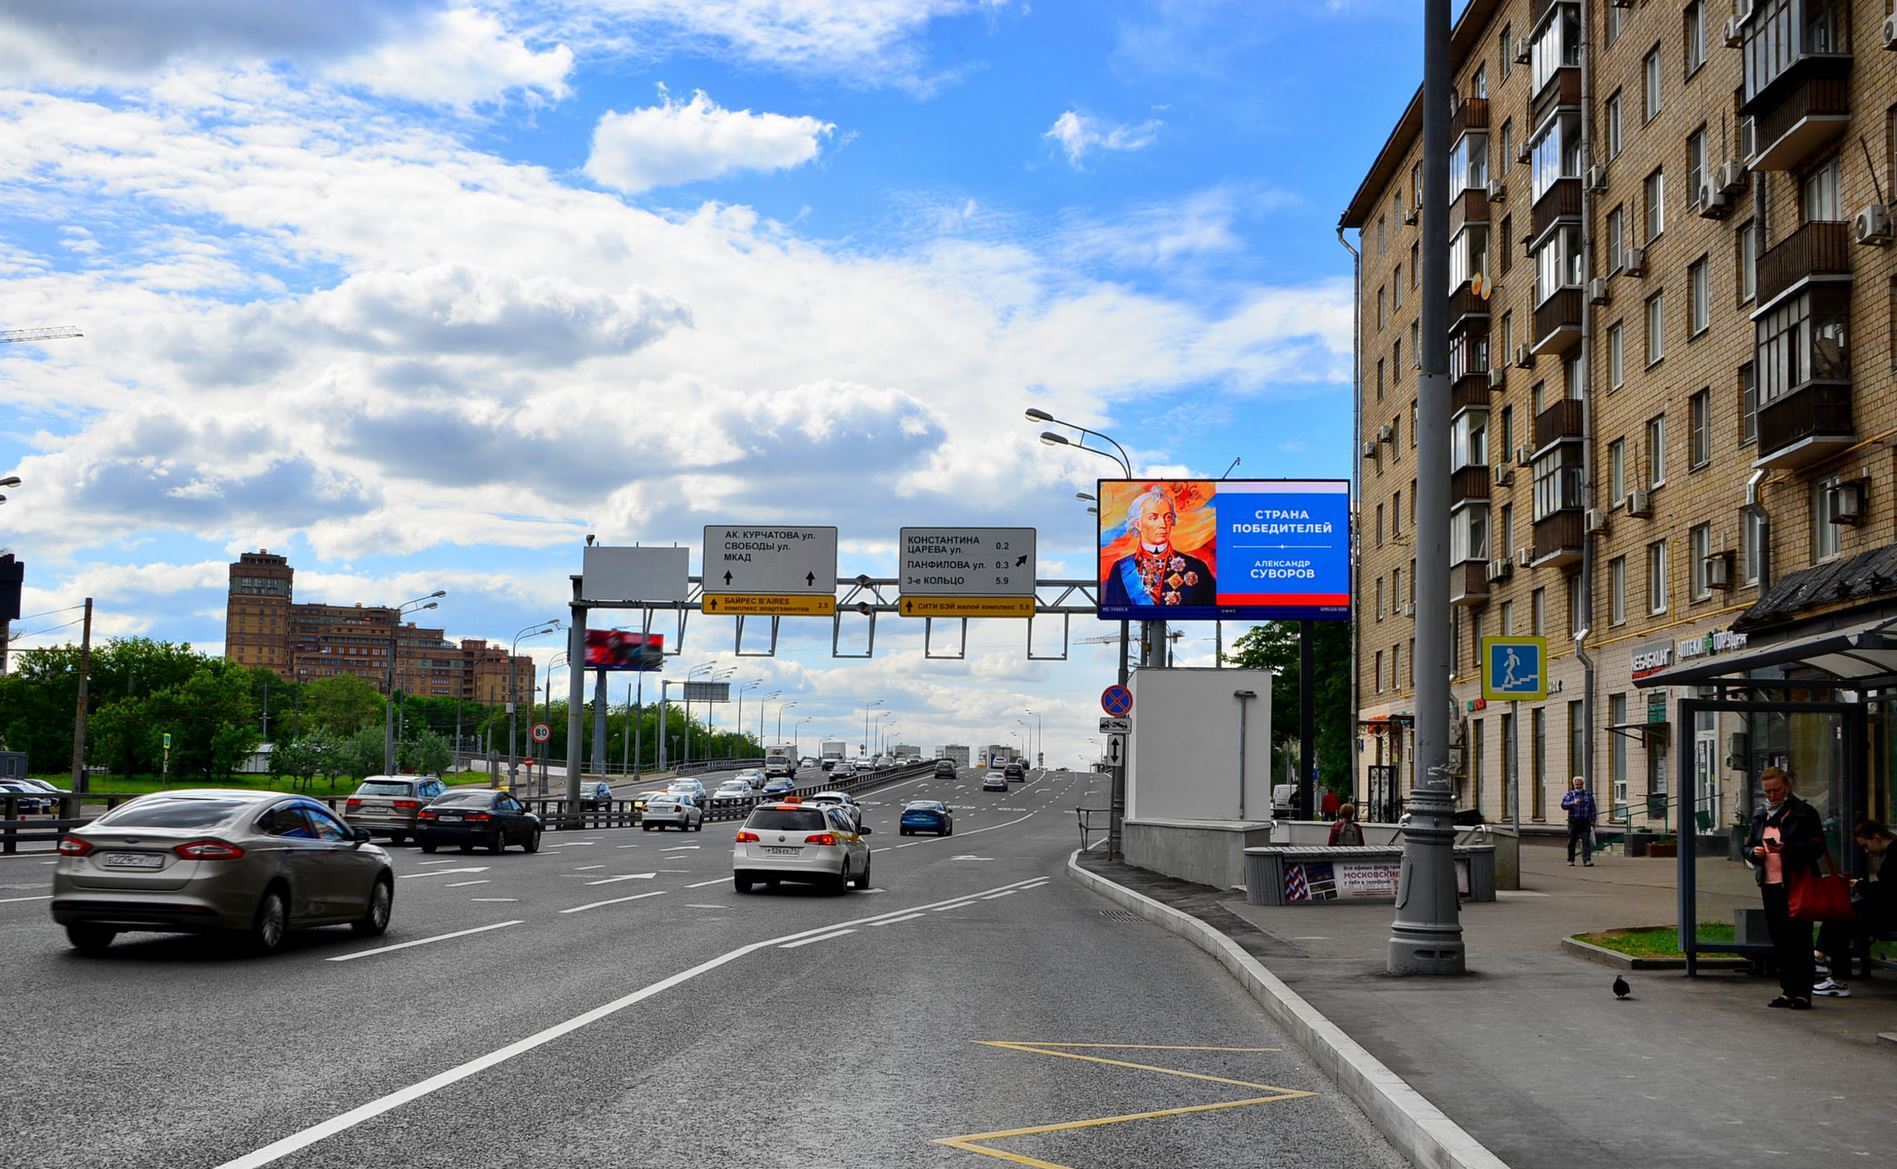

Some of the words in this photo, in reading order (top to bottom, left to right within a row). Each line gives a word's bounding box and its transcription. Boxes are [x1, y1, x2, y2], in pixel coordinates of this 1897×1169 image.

[1255, 510, 1309, 519] СТРАНА
[1233, 522, 1332, 534] ПОБЕДИТЕЛЕЙ
[725, 531, 741, 540] АК.
[743, 531, 799, 540] КУРЧАТОВА
[802, 532, 816, 541] ул.
[907, 536, 980, 544] КОНСТАНТИНА
[724, 542, 775, 551] СВОБОДЫ
[777, 543, 791, 552] ул.
[907, 546, 947, 554] ЦАРЕВА
[950, 547, 964, 555] ул.
[995, 542, 1009, 550] 0.2
[724, 553, 752, 562] МКАД
[907, 561, 970, 569] ПАНФИЛОВА
[973, 562, 987, 570] ул.
[995, 561, 1009, 569] 0.3
[1255, 560, 1311, 568] АЛЕКСАНДР
[1250, 569, 1315, 579] СУВОРОВ
[924, 577, 965, 586] КОЛЬЦО
[1678, 638, 1703, 656] АПТЕКИ
[535, 728, 547, 737] 80
